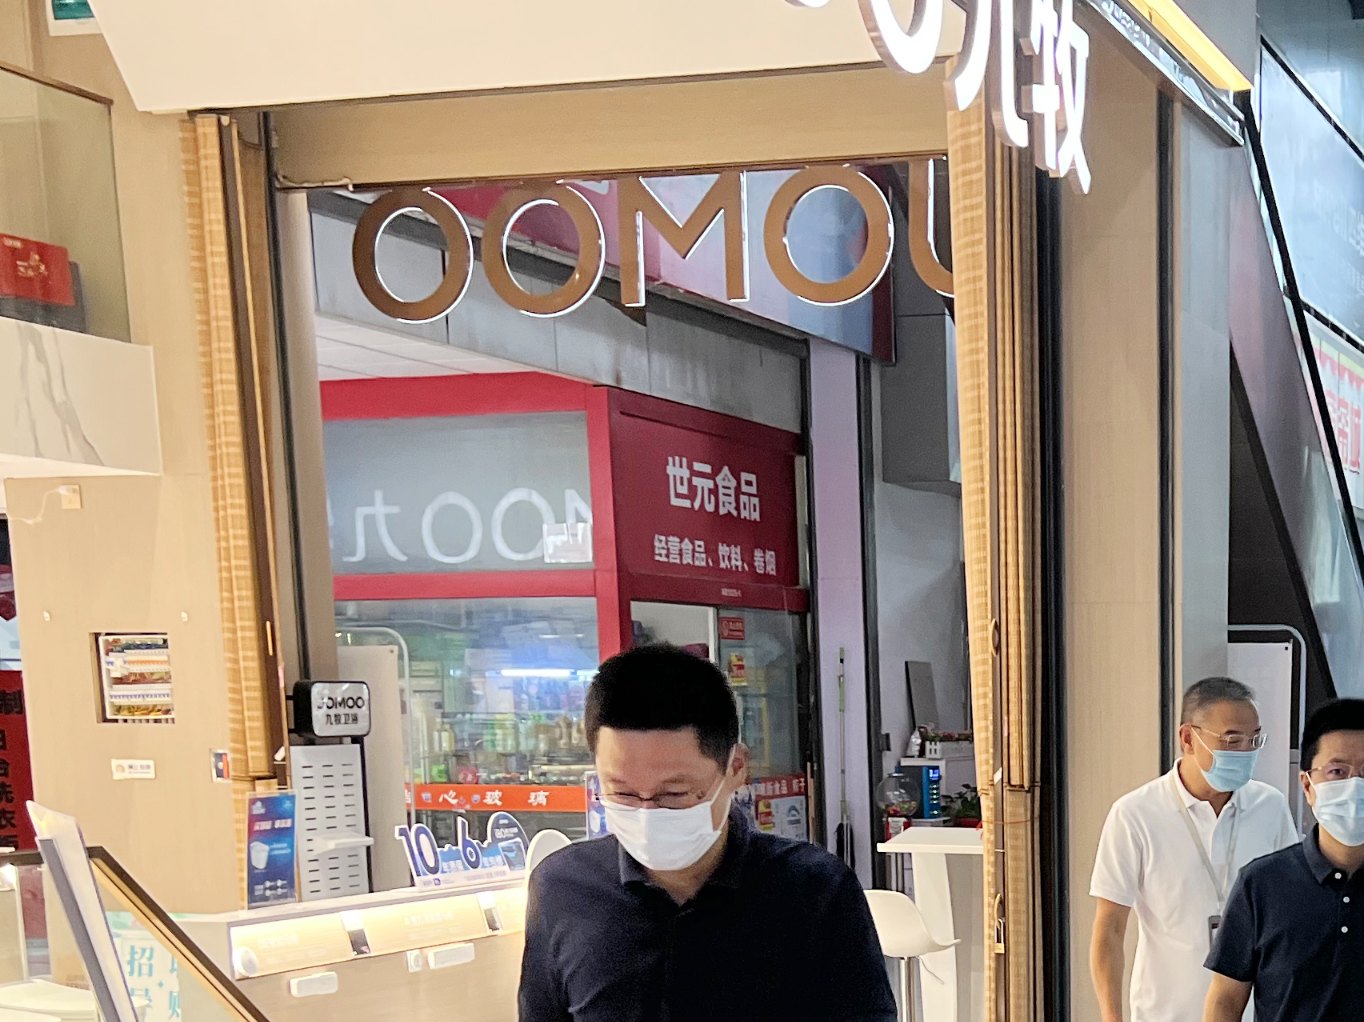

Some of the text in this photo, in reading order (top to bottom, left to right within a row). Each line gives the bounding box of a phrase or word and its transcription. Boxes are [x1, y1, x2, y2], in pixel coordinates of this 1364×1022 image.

[666, 455, 761, 521] 世元食品
[653, 533, 777, 576] 经营食品、饮料、卷烟
[317, 696, 366, 710] JOMOO
[325, 711, 359, 726] 九牧卫浴
[398, 826, 440, 876] 10
